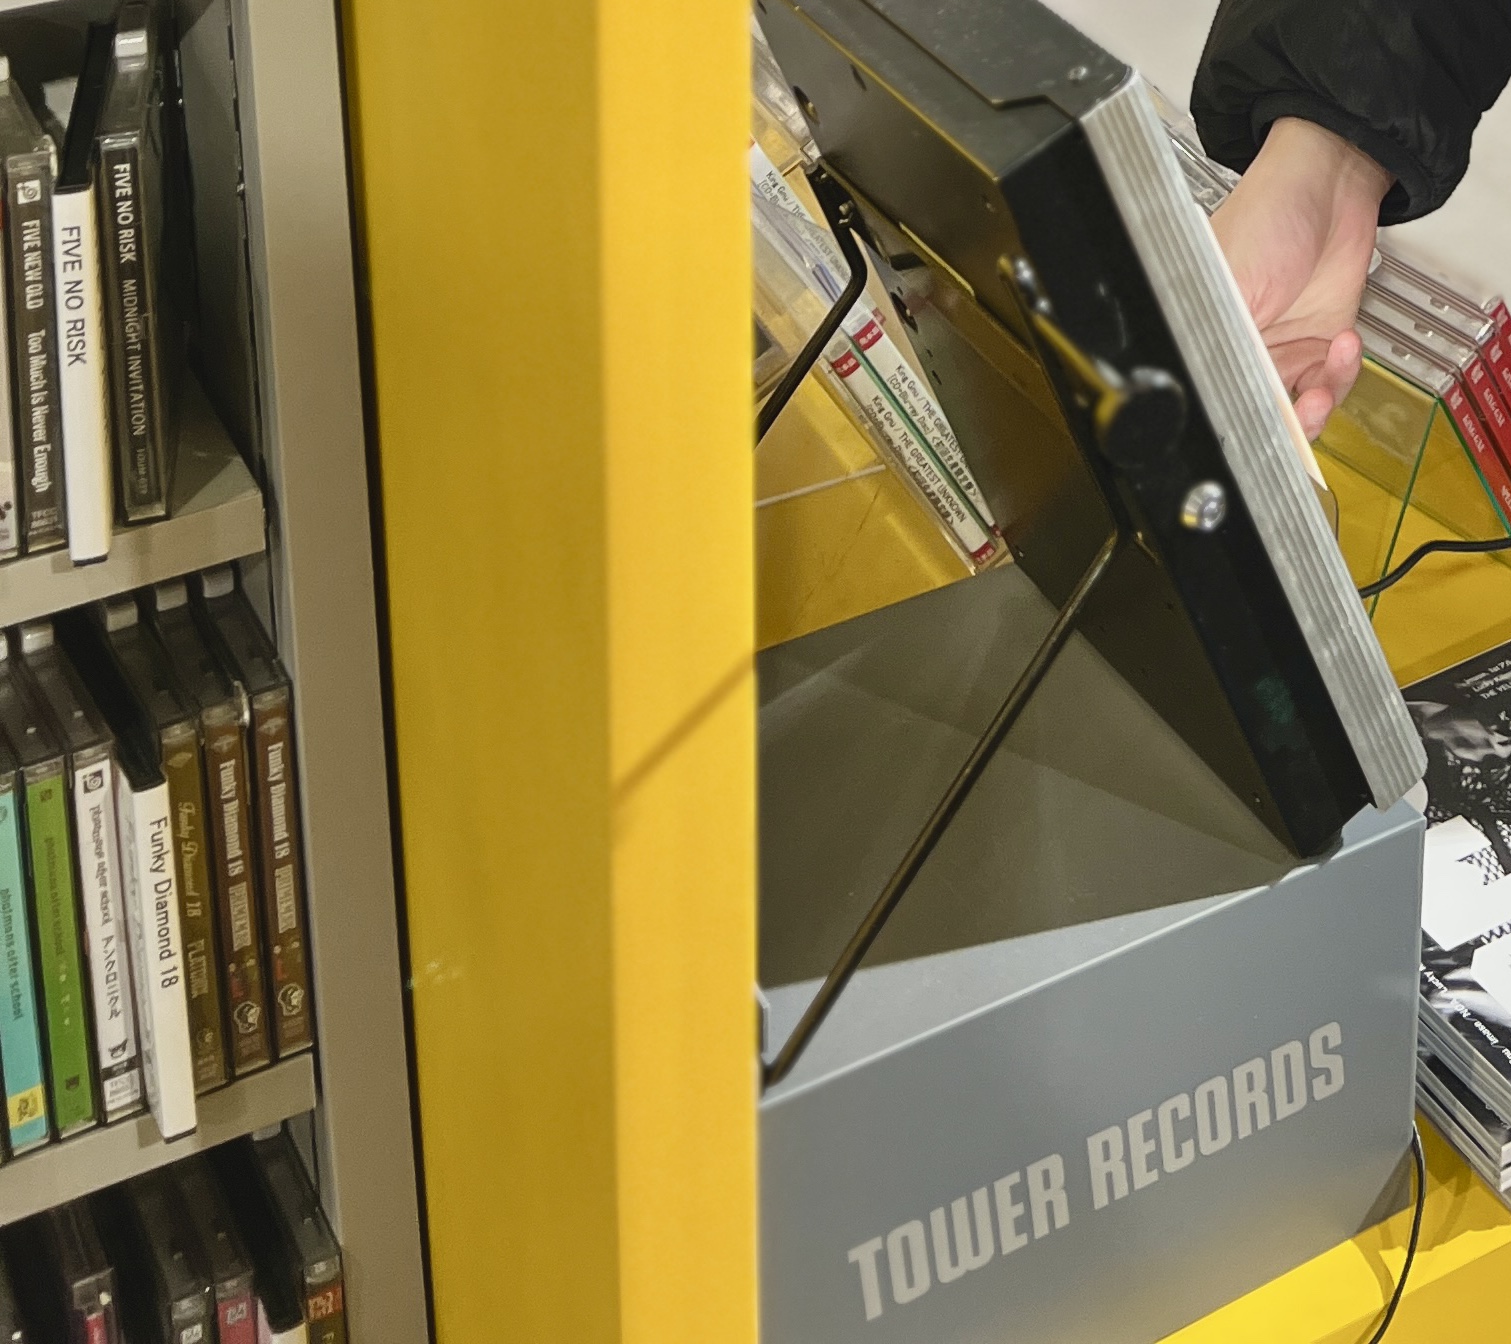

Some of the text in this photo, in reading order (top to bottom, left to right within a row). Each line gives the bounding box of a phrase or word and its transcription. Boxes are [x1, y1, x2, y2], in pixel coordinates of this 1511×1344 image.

[113, 162, 132, 198] FIVE
[116, 199, 135, 225] NO
[118, 228, 137, 264] RISK
[62, 225, 87, 366] FIVE NO RISK
[122, 278, 142, 351] MIDNIGHT
[21, 219, 52, 492] FIVE NEW OLD Too Much Is Never Enough
[127, 355, 146, 436] INVITATION
[892, 363, 911, 383] King
[905, 379, 922, 398] Gnu
[919, 399, 938, 419] THE
[869, 394, 968, 522] King Gnu THE GREATEST UNKNOWN
[218, 758, 237, 799] Funky
[267, 741, 284, 781] Funky
[223, 799, 244, 859] Diamond
[270, 782, 289, 841] Diamond
[228, 860, 243, 877] 18
[274, 842, 290, 860] 18
[149, 816, 179, 989] Funky Diamond 18
[186, 901, 202, 917] 18
[10, 980, 24, 1021] school
[1464, 1020, 1502, 1045] imase
[847, 1021, 1346, 1322] TOWER RECORDS
